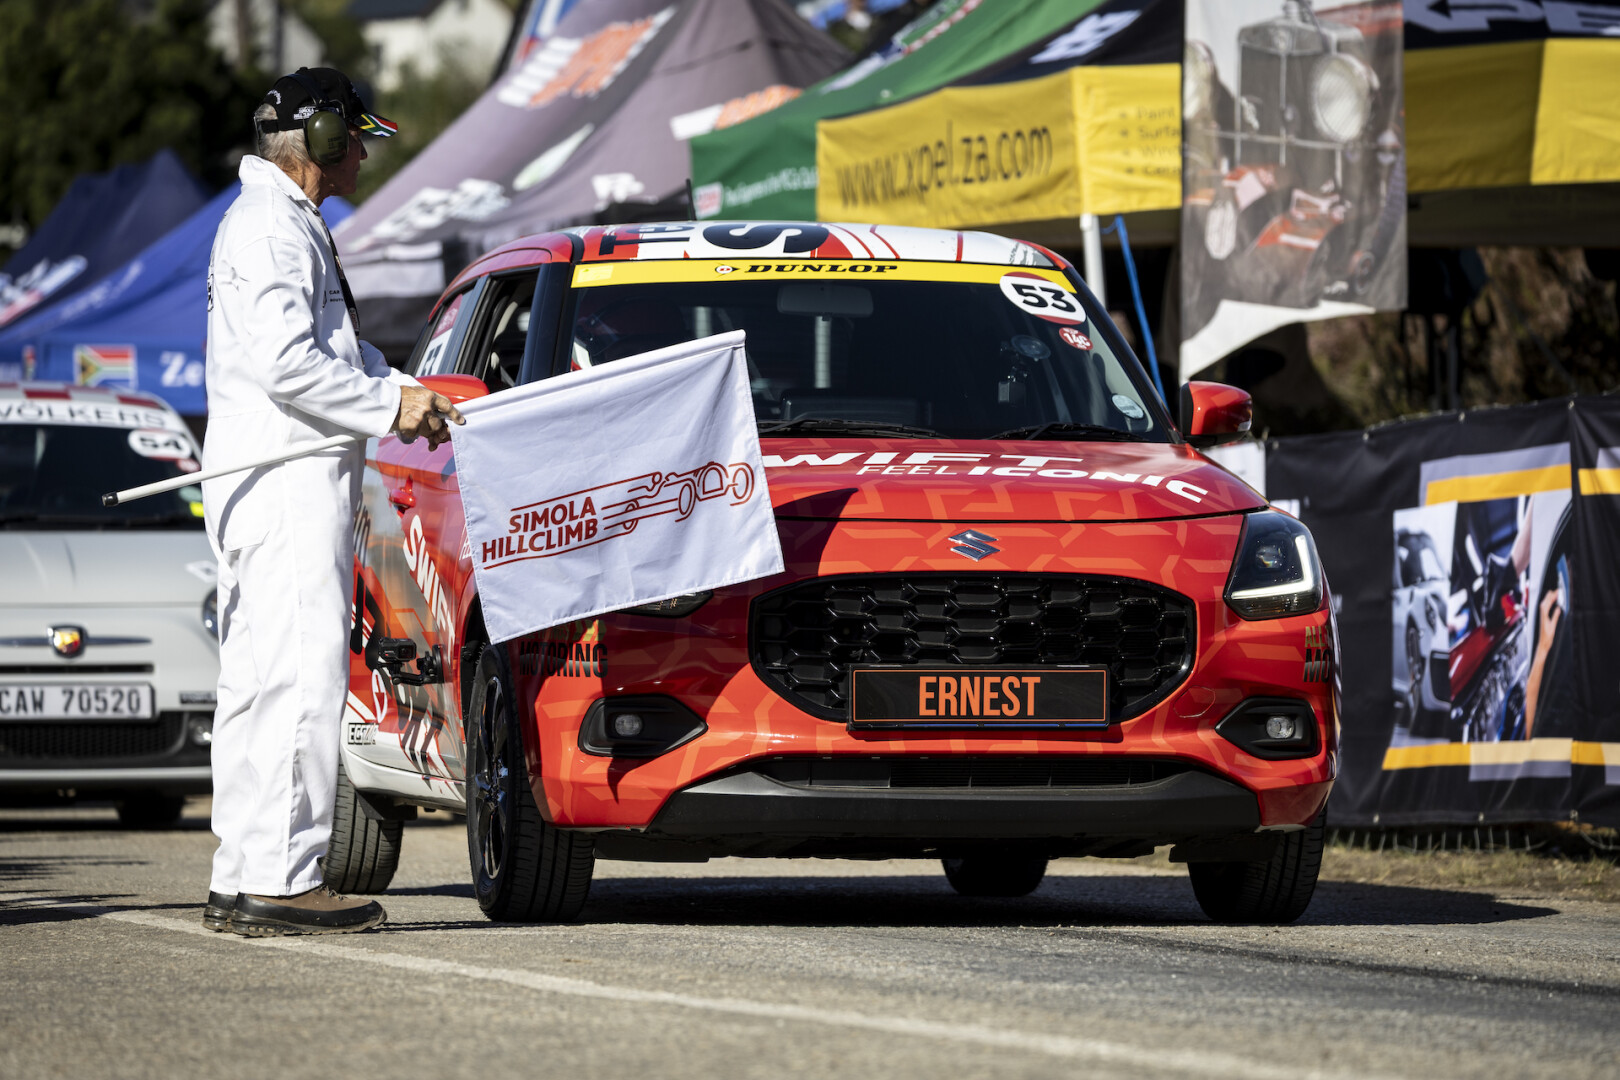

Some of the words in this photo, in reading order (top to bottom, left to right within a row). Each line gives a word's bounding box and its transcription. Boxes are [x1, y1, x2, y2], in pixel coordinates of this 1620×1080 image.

[744, 264, 898, 273] DUNLOP
[1011, 283, 1077, 313] 53
[139, 437, 183, 451] 54
[855, 465, 958, 476] FEEL
[966, 466, 1209, 503] ICONIC
[508, 496, 597, 534] SIMOLA
[482, 518, 599, 563] HILLCLIMB
[402, 514, 456, 664] SWIFT
[519, 641, 608, 678] MOTORING
[0, 689, 45, 714] CAW
[61, 688, 141, 715] 70520
[918, 676, 1041, 716] ERNEST
